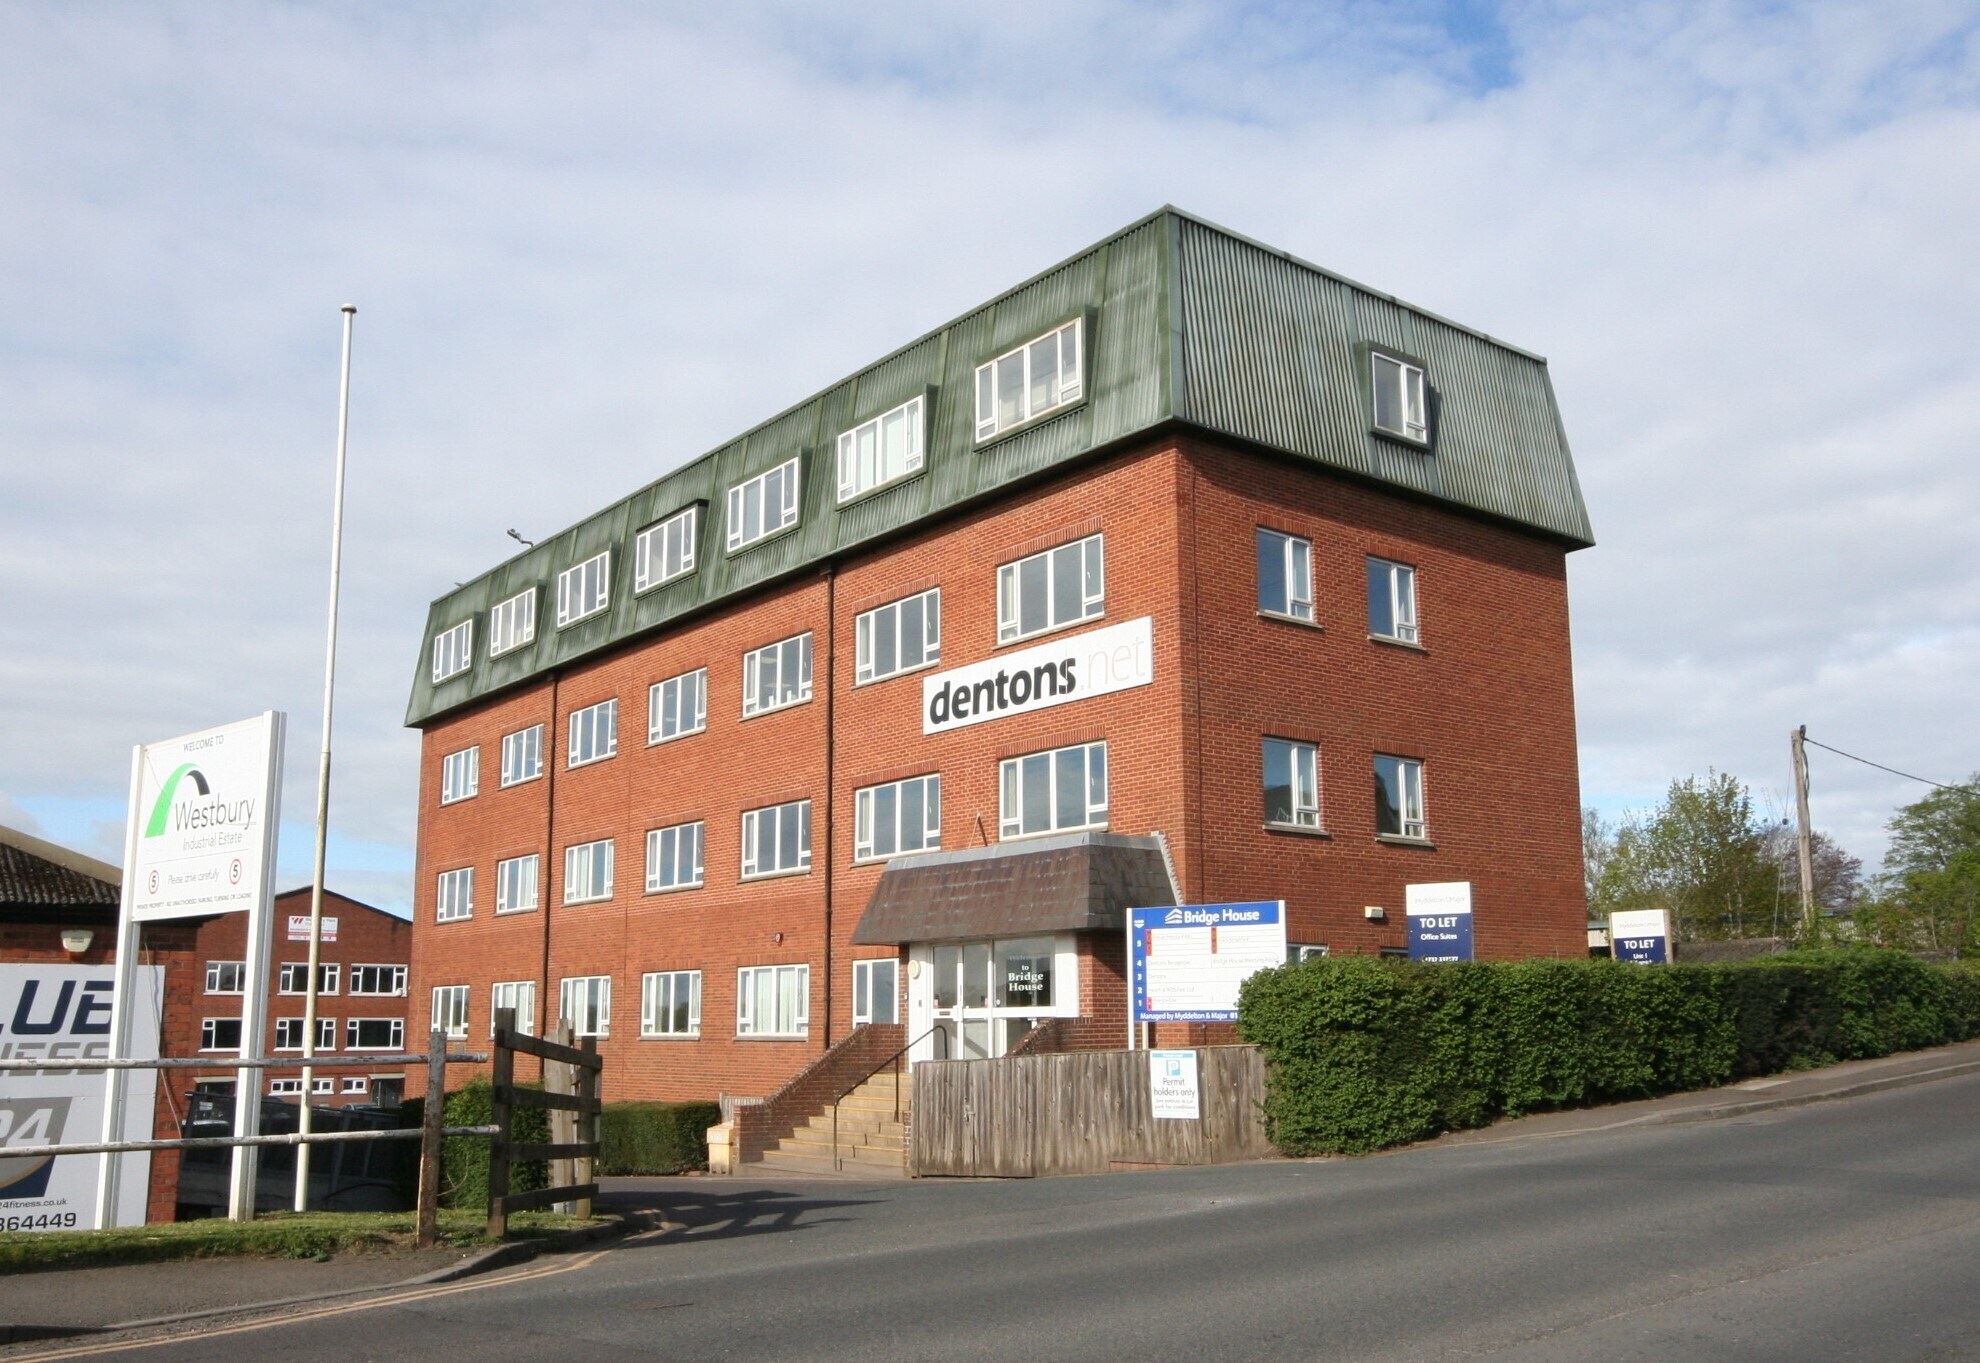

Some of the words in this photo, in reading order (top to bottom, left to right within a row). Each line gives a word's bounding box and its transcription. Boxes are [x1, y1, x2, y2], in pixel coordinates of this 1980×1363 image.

[930, 635, 1146, 725] dentons.net
[183, 737, 214, 752] WELCOME
[215, 734, 224, 745] TO
[175, 793, 256, 831] Westbury
[183, 834, 217, 851] Industrial
[218, 832, 243, 846] Estate
[233, 864, 239, 878] 5
[151, 875, 156, 888] 5
[1184, 908, 1220, 926] Bridge
[1222, 908, 1260, 921] House
[1419, 917, 1436, 928] TO
[1438, 916, 1458, 928] LET
[1440, 932, 1457, 940] Suites
[1623, 940, 1638, 949] TO
[1639, 939, 1655, 948] LET
[1008, 972, 1044, 983] Bridge
[1008, 982, 1044, 992] House
[1140, 1012, 1166, 1021] Managed
[1166, 1012, 1174, 1020] by
[1174, 1012, 1205, 1020] Myddelton
[1211, 1012, 1228, 1020] Major
[1162, 1077, 1185, 1086] Permit
[1153, 1087, 1179, 1096] holders
[1180, 1087, 1195, 1098] only
